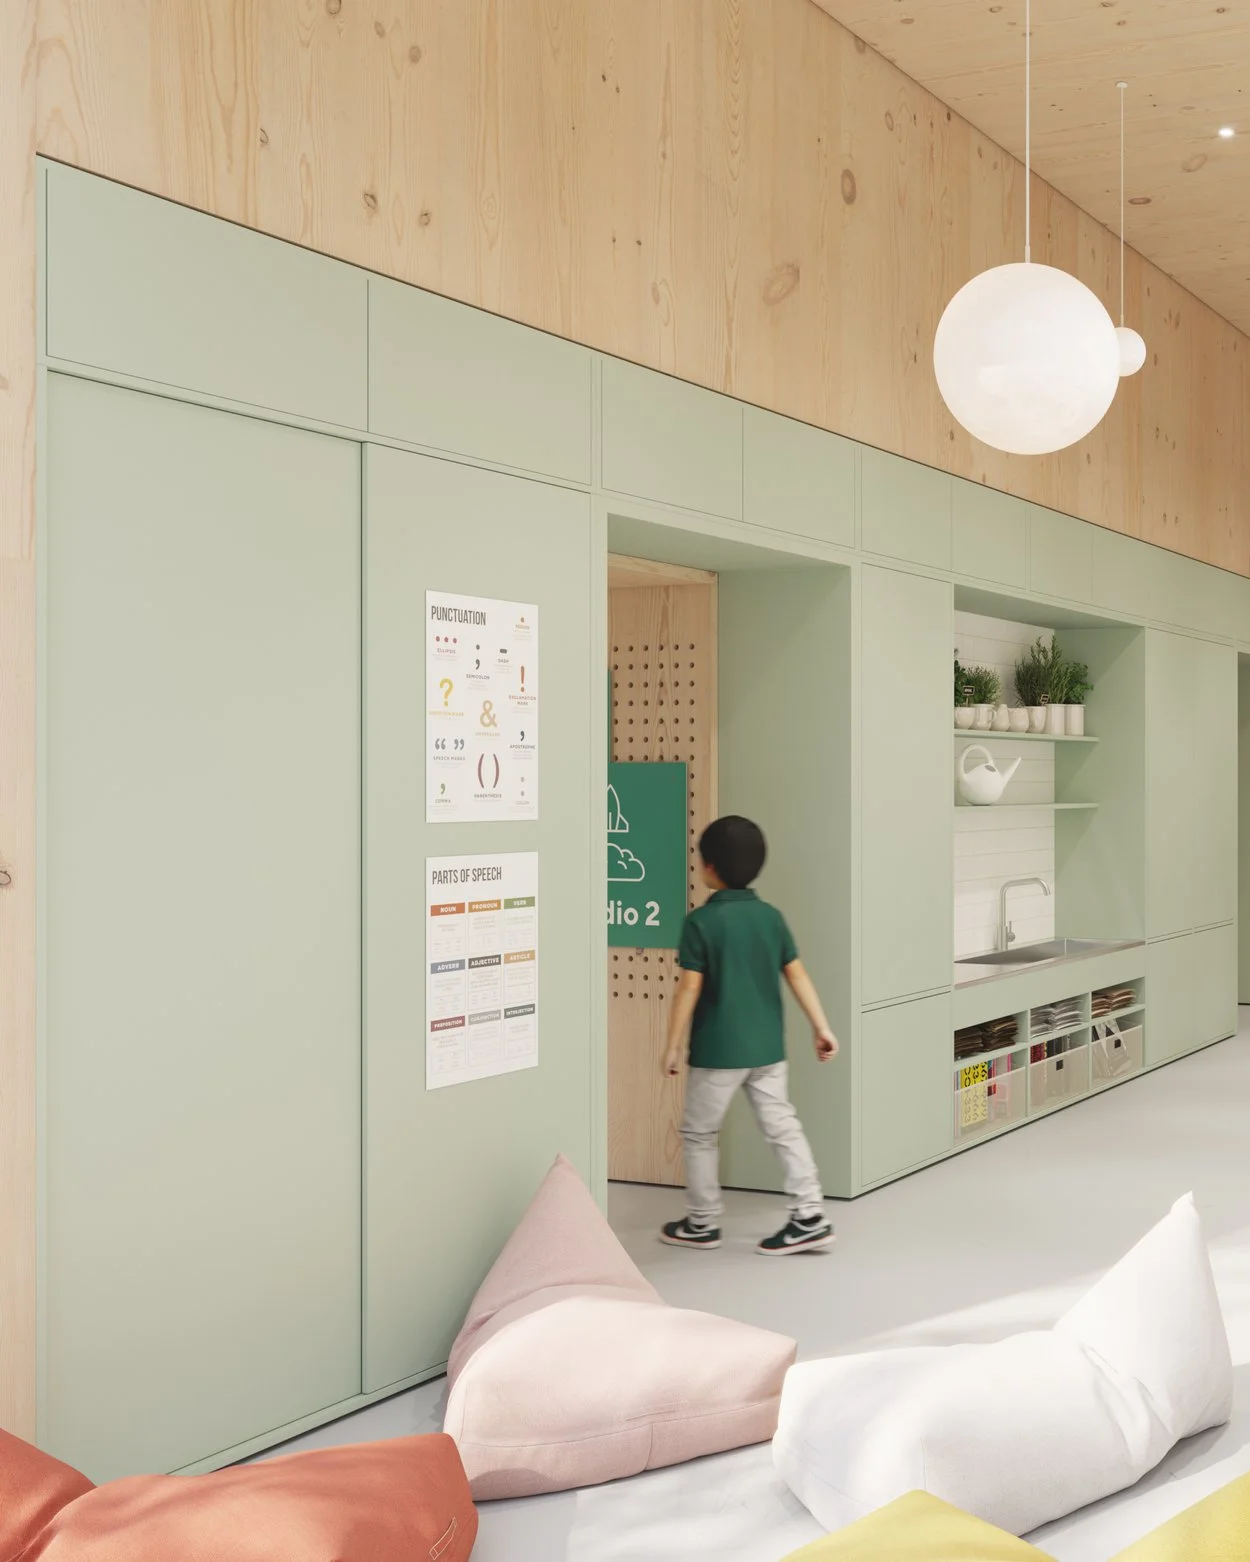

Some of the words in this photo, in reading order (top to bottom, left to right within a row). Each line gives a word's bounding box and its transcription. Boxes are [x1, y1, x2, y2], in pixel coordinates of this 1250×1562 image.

[431, 605, 486, 626] PUNCTUATION
[432, 869, 459, 885] PARTS
[460, 868, 470, 883] OF
[472, 866, 502, 882] SPEECH
[472, 902, 498, 911] PRONOUN
[607, 900, 639, 926] dio
[645, 901, 660, 926] 2
[437, 962, 460, 971] ADVERB
[470, 957, 500, 967] ADJECTIVE
